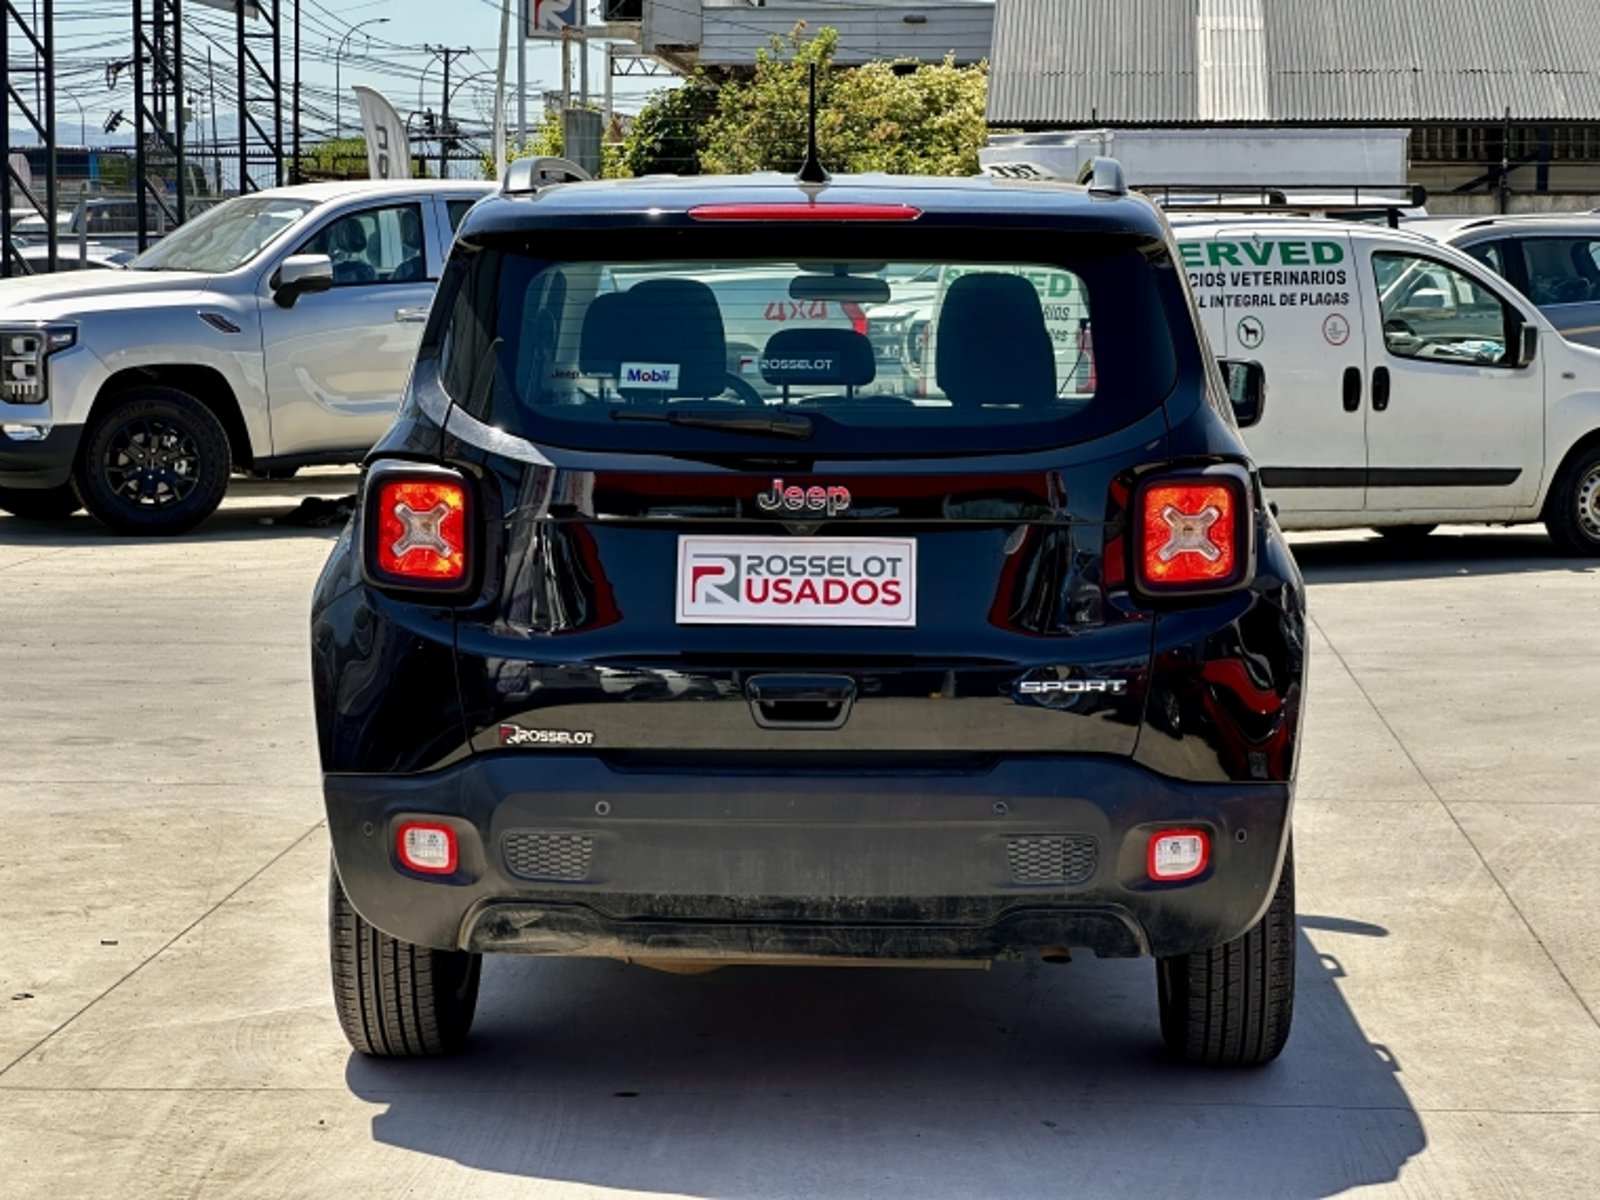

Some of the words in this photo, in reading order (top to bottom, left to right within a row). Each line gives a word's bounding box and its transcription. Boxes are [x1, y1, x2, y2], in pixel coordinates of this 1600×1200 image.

[1230, 269, 1347, 288] VETERINARIOS
[1209, 292, 1276, 309] INTEGRAL
[1279, 293, 1297, 307] DE
[1300, 291, 1350, 307] PLAGAS
[761, 358, 833, 371] ROSSELOT
[627, 367, 671, 383] Mobil
[757, 478, 852, 517] Jeep
[746, 554, 903, 578] ROSSELOT
[744, 578, 902, 606] USADOS
[1020, 679, 1128, 693] SPORT
[519, 729, 594, 744] ROSSELOT
